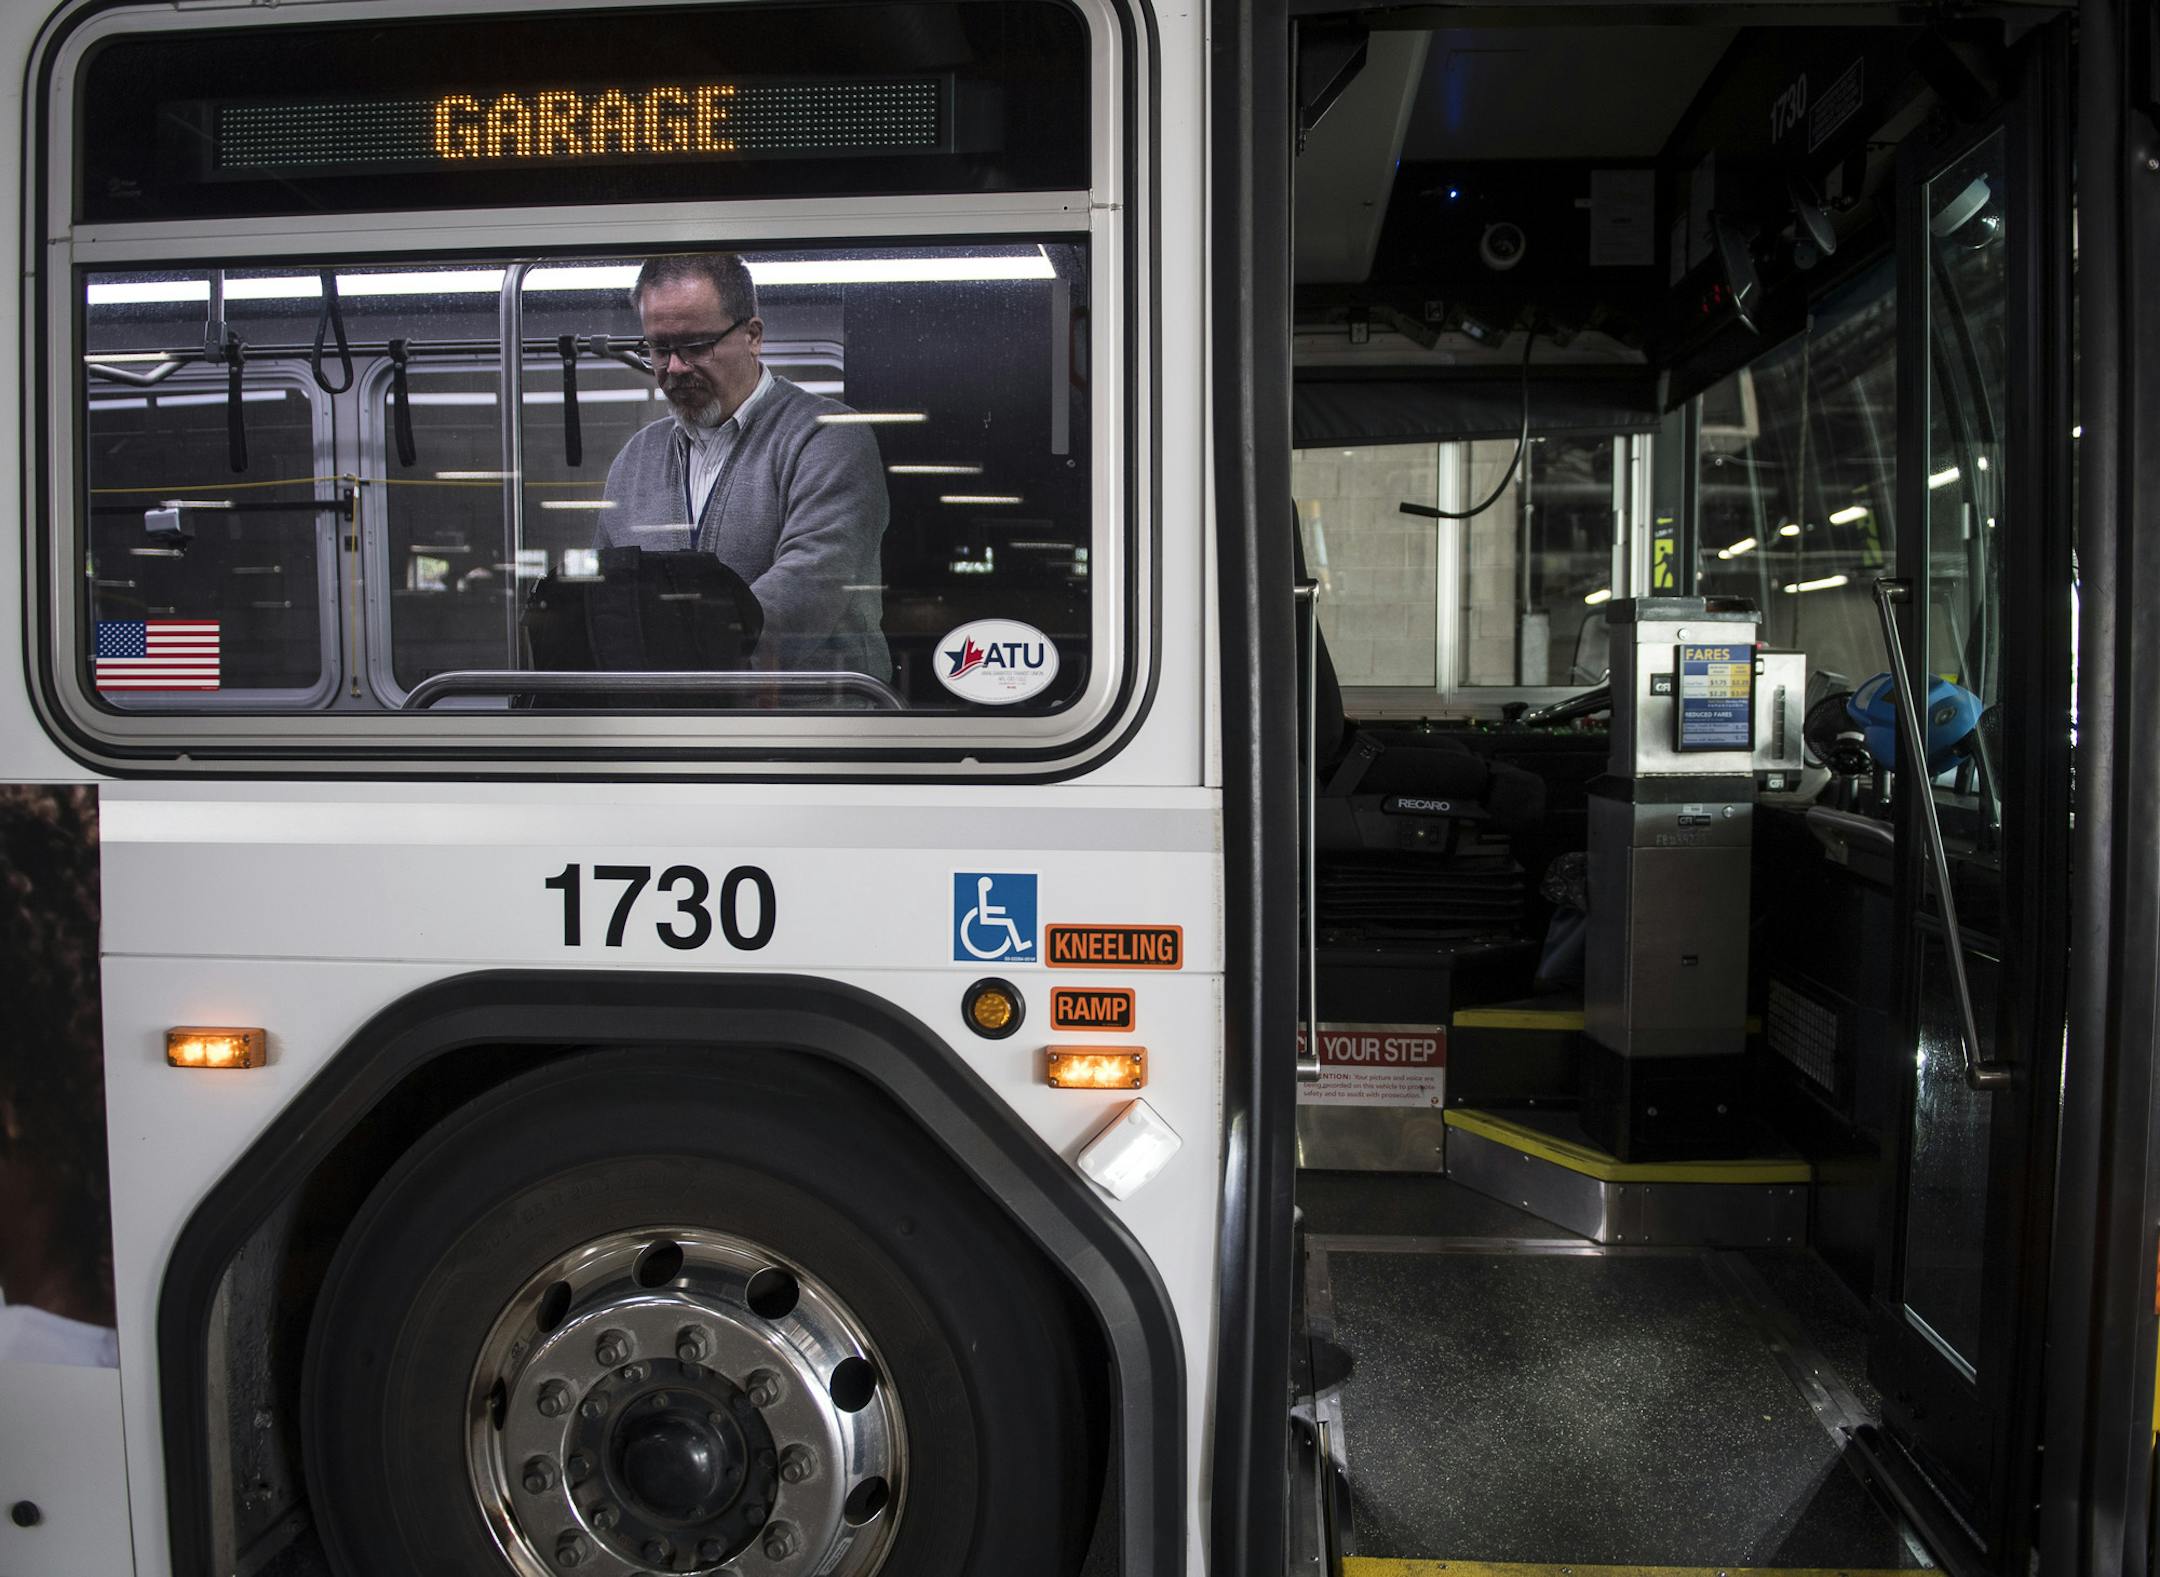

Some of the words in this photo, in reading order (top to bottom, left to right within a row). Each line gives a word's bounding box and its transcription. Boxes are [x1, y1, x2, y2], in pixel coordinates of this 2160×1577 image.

[434, 84, 736, 159] GARAGE
[1769, 72, 1807, 145] 1730
[983, 642, 1044, 669] ATU
[1685, 648, 1730, 660] FARES
[1398, 798, 1450, 811] RECARO
[545, 863, 777, 951] 1730
[1056, 932, 1174, 961] KNEELING
[1057, 996, 1127, 1021] RAMP
[1325, 1037, 1380, 1061] YOUR
[1385, 1039, 1437, 1062] STEP
[1304, 1090, 1322, 1098] safety
